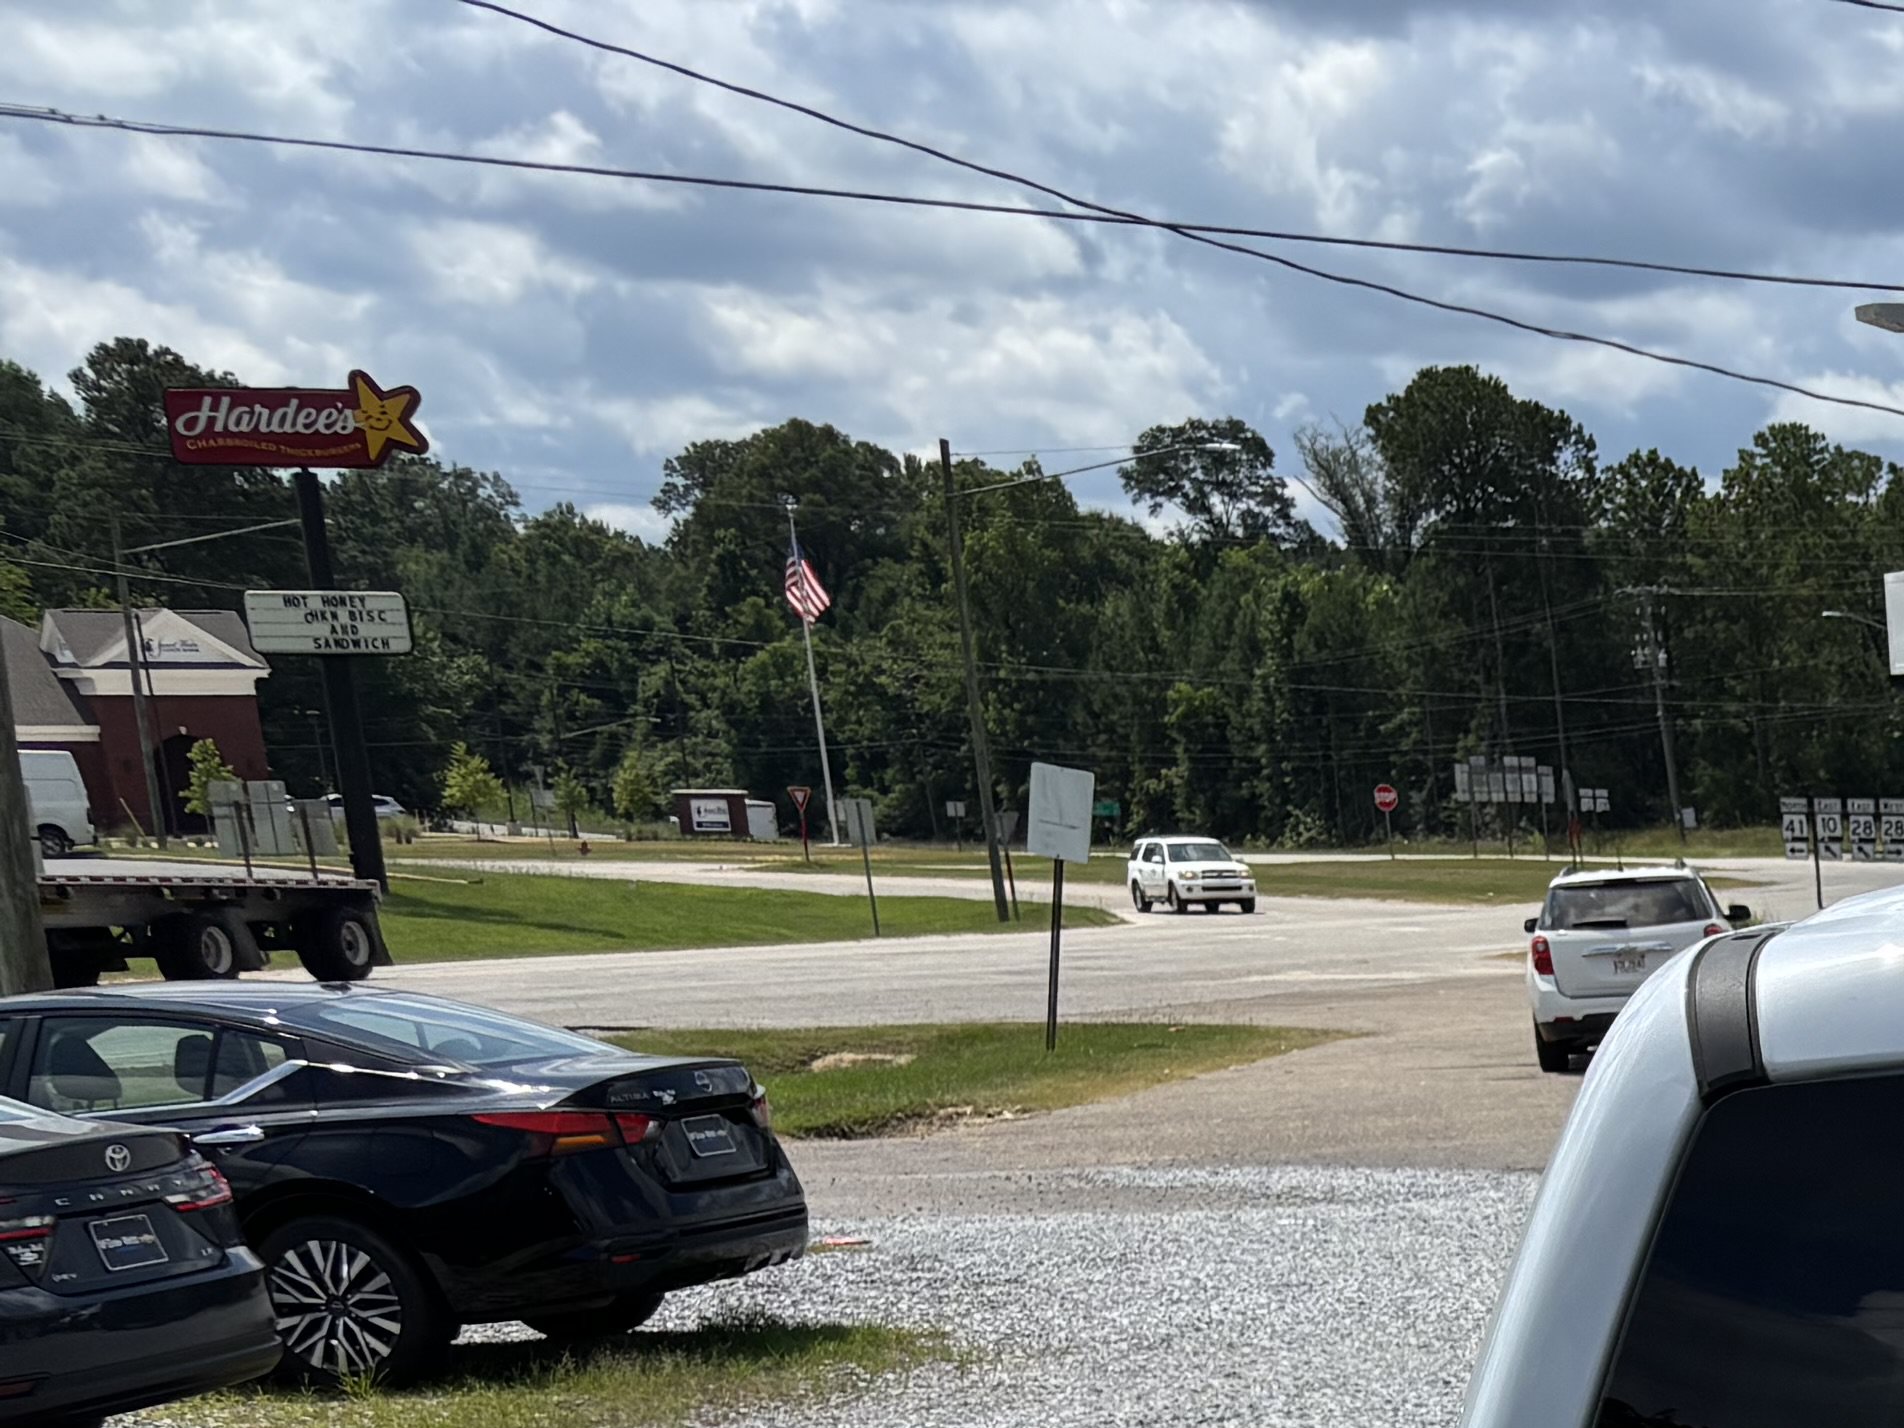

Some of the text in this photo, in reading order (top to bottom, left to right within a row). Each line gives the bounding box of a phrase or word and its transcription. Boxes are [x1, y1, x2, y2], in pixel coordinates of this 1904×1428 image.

[175, 396, 358, 437] Hardee's
[283, 595, 367, 609] HOT HONEY
[350, 610, 388, 622] BISC
[330, 624, 359, 635] AND
[314, 637, 390, 650] SANDWICH
[1785, 819, 1804, 835] 41
[1821, 817, 1838, 833] 10
[1851, 820, 1873, 836] 28
[1884, 820, 1904, 836] 28
